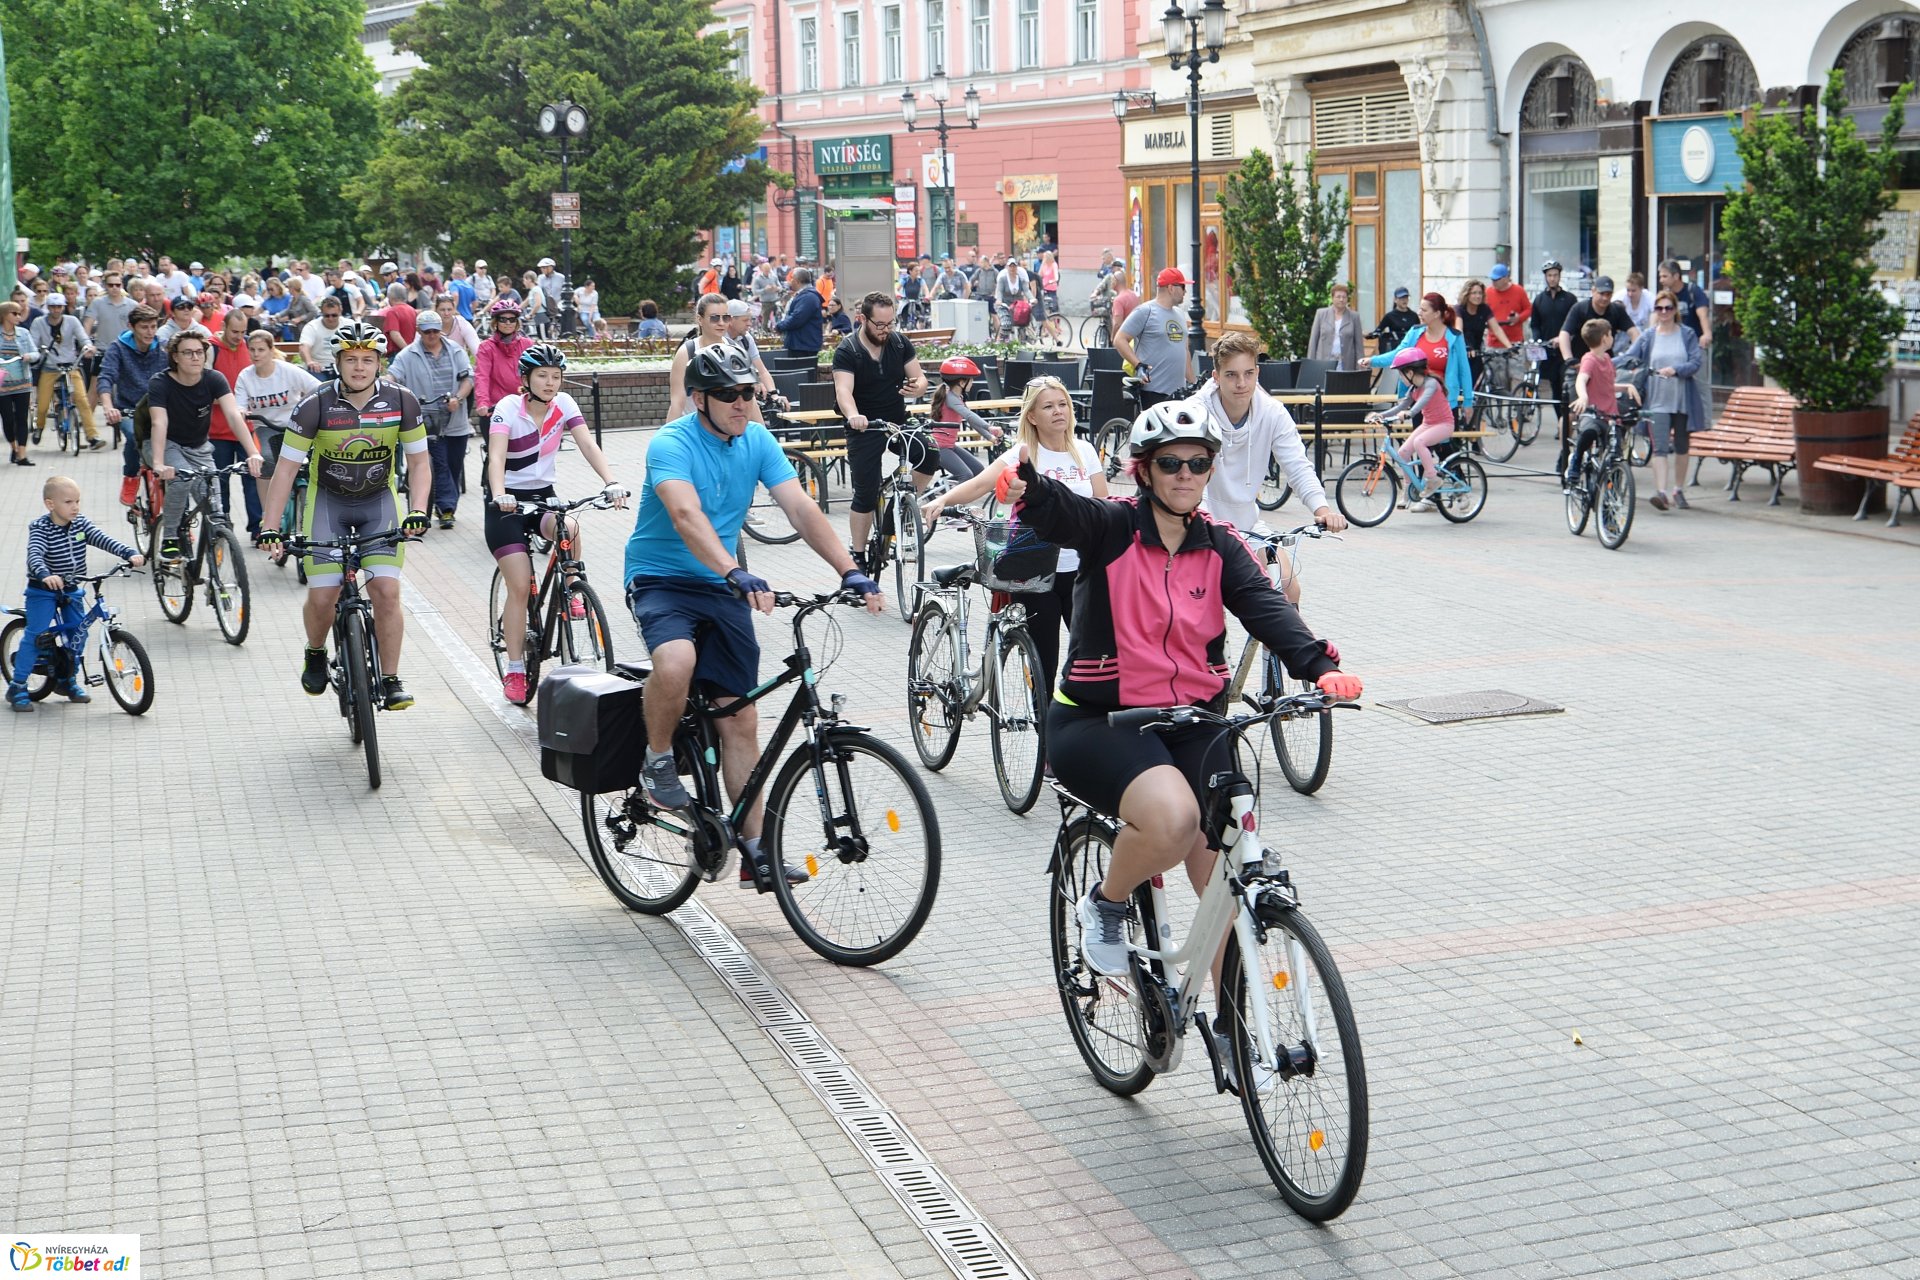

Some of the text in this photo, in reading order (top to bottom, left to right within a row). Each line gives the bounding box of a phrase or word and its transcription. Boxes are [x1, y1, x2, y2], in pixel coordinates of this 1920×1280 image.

[1144, 131, 1186, 150] MARELLA
[821, 140, 882, 164] NYÍRSÉG
[362, 450, 387, 459] MTB
